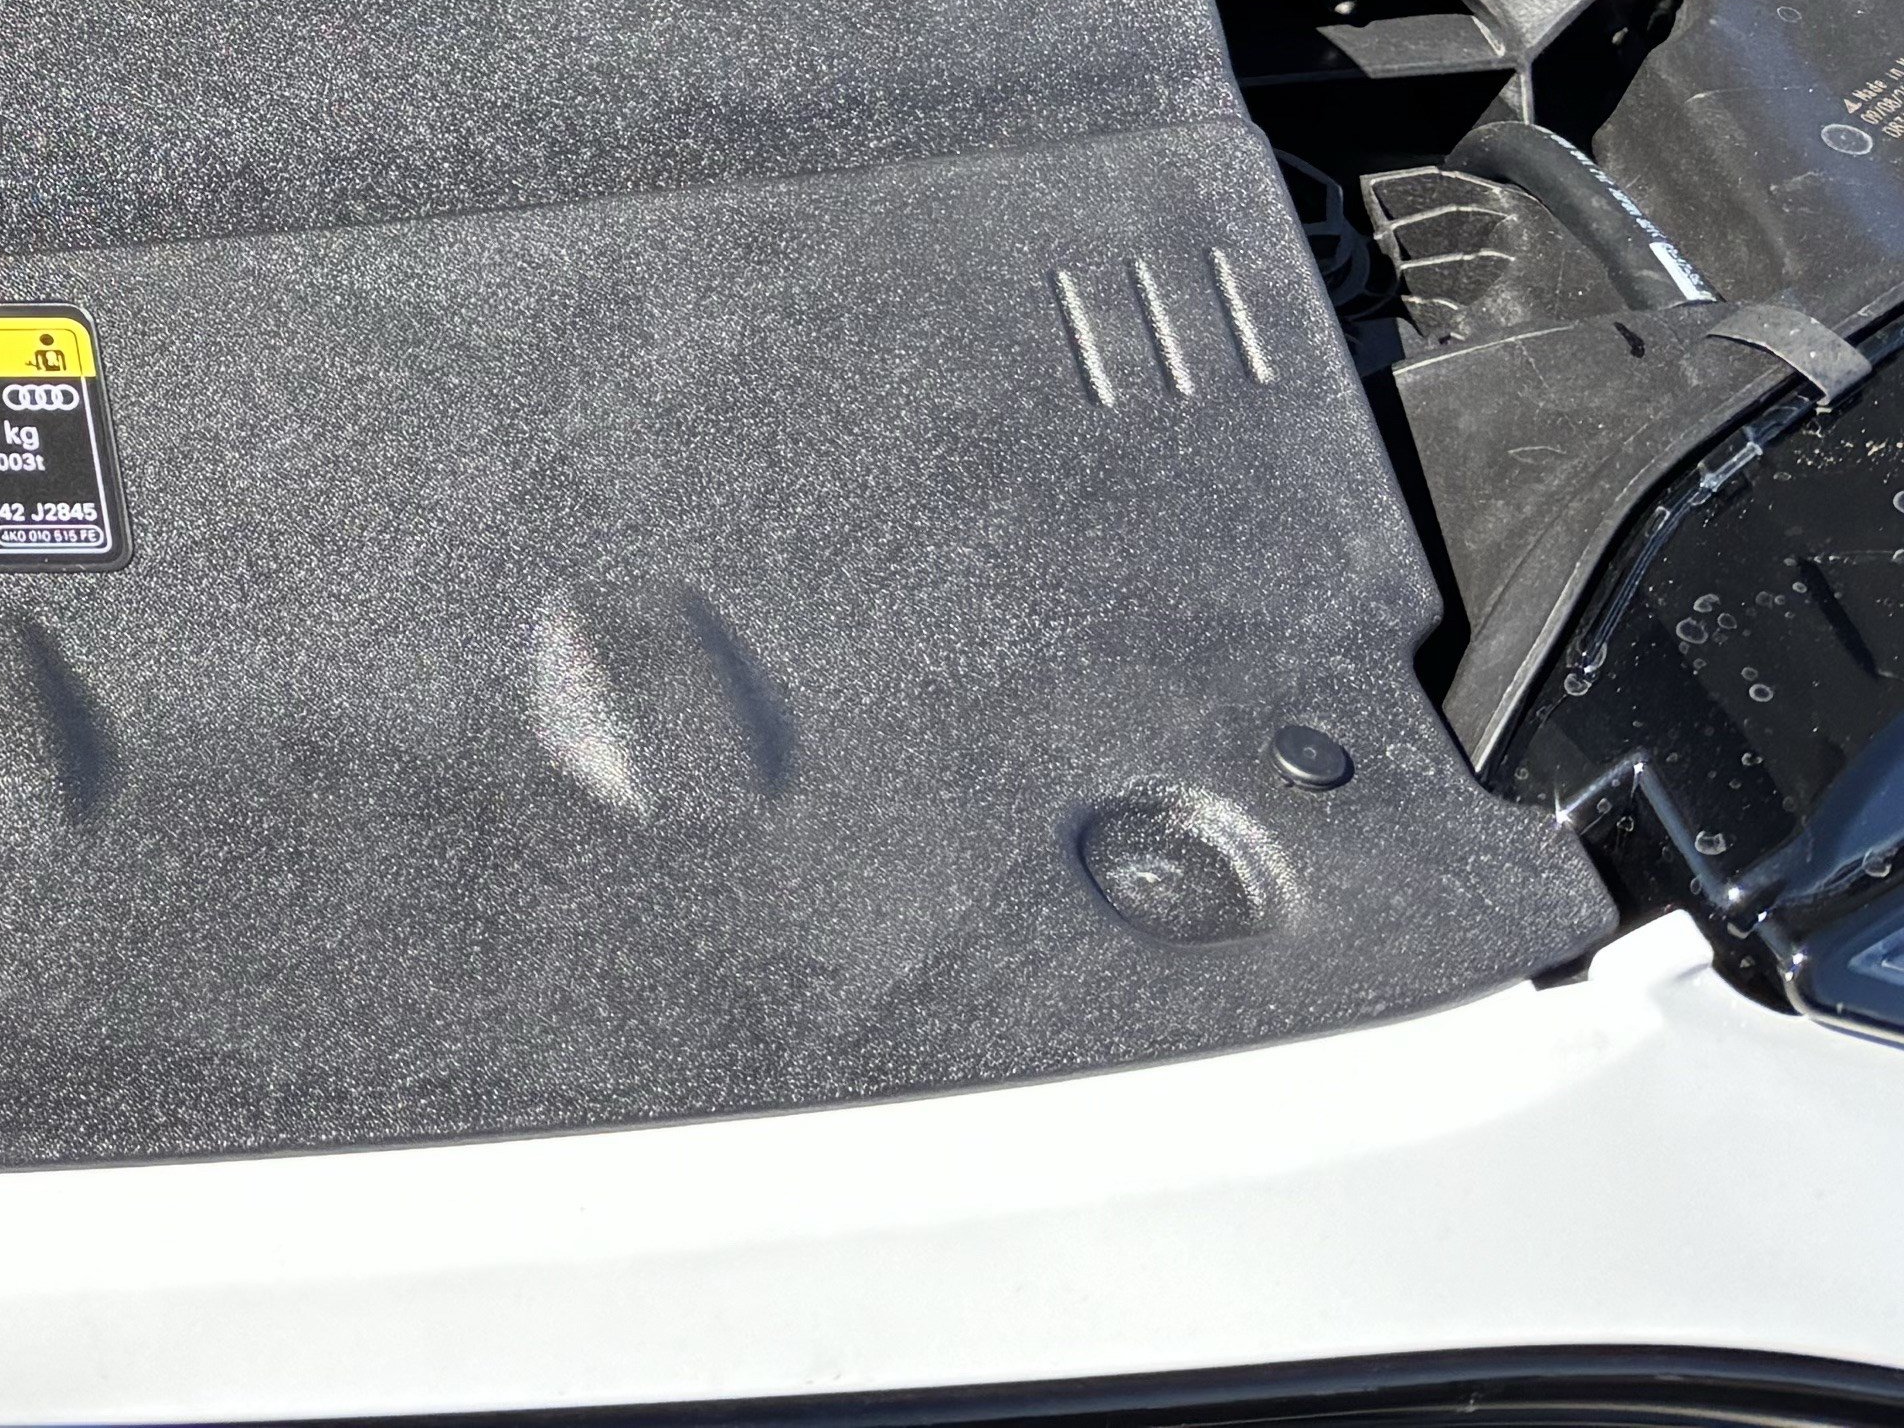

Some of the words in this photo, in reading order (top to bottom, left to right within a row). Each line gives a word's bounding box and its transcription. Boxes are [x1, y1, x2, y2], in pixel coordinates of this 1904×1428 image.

[4, 419, 39, 450] kg
[31, 502, 97, 522] J2845
[29, 530, 51, 541] 010
